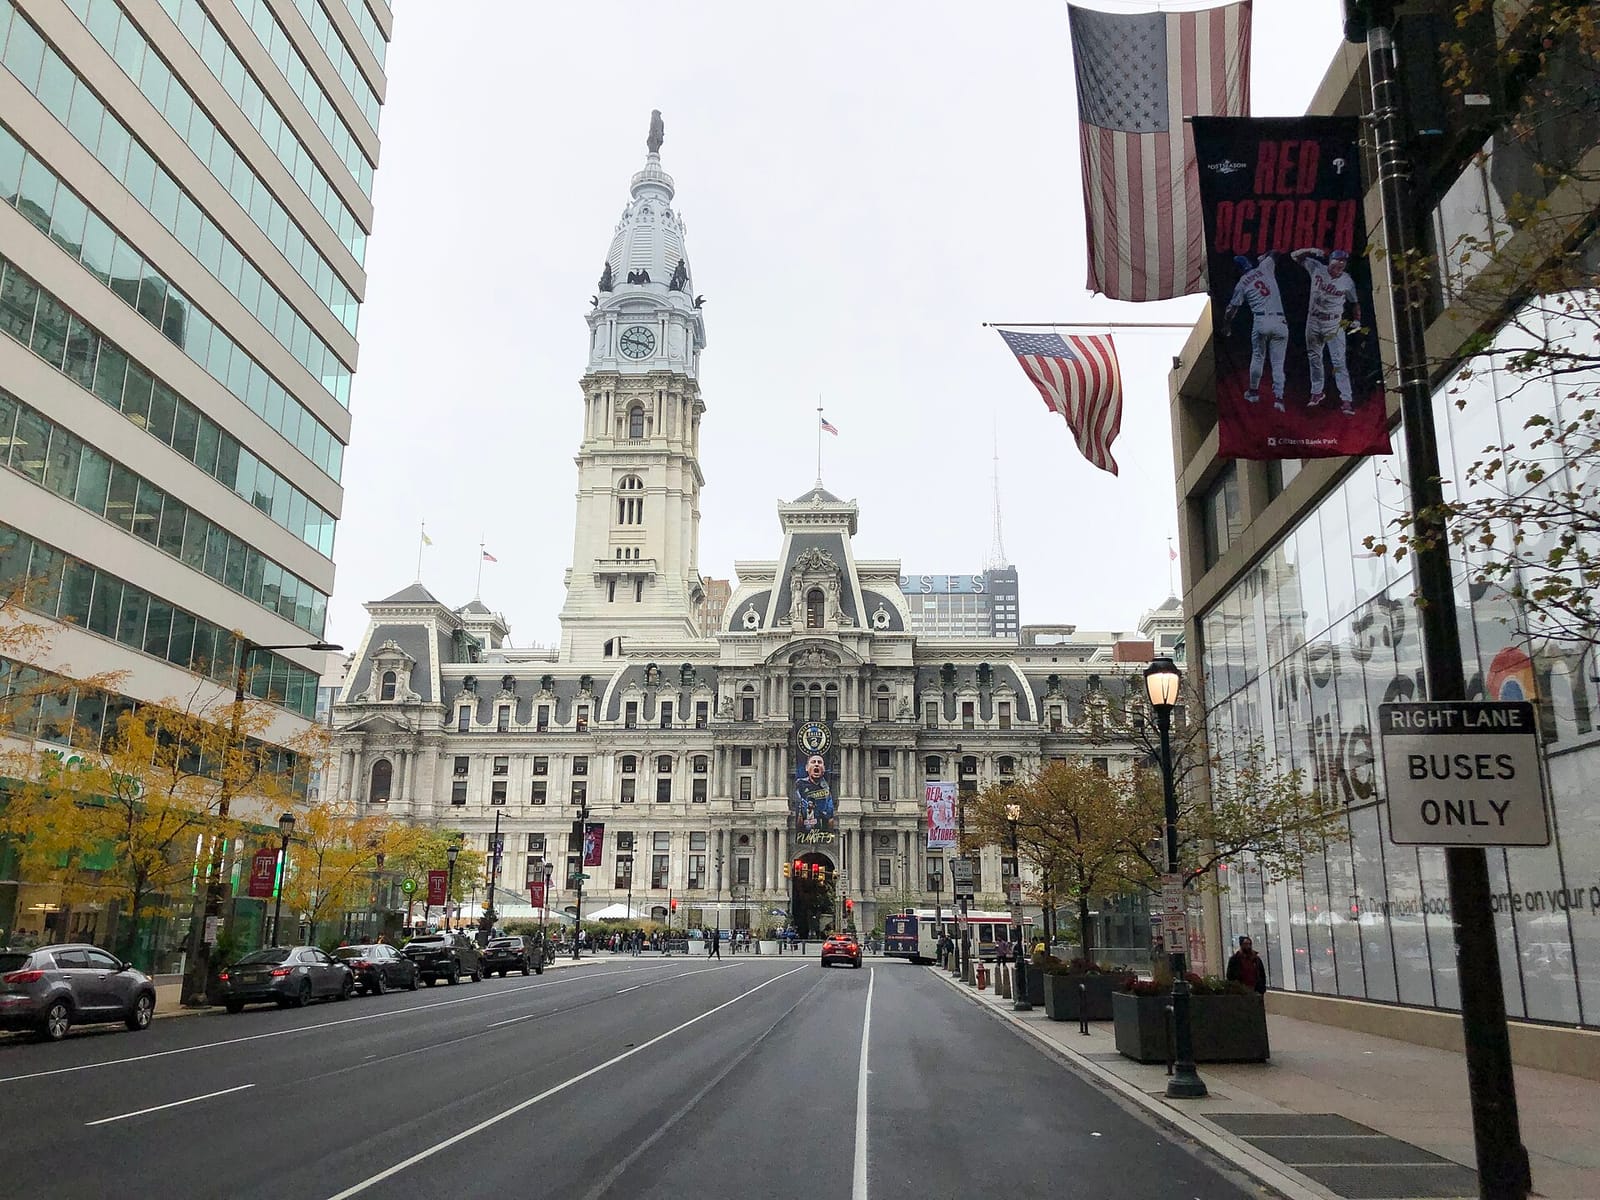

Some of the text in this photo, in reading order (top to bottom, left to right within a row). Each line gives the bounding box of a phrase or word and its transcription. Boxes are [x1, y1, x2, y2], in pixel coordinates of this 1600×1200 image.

[1254, 140, 1320, 194] RED
[1215, 199, 1356, 256] OCTOBER
[1254, 280, 1271, 297] 3
[1322, 437, 1338, 445] Park
[1391, 709, 1523, 728] RIGHT LANE
[1408, 754, 1516, 780] BUSES
[926, 787, 941, 801] RED
[1420, 799, 1512, 826] ONLY
[1526, 888, 1543, 911] on
[1546, 882, 1584, 911] your
